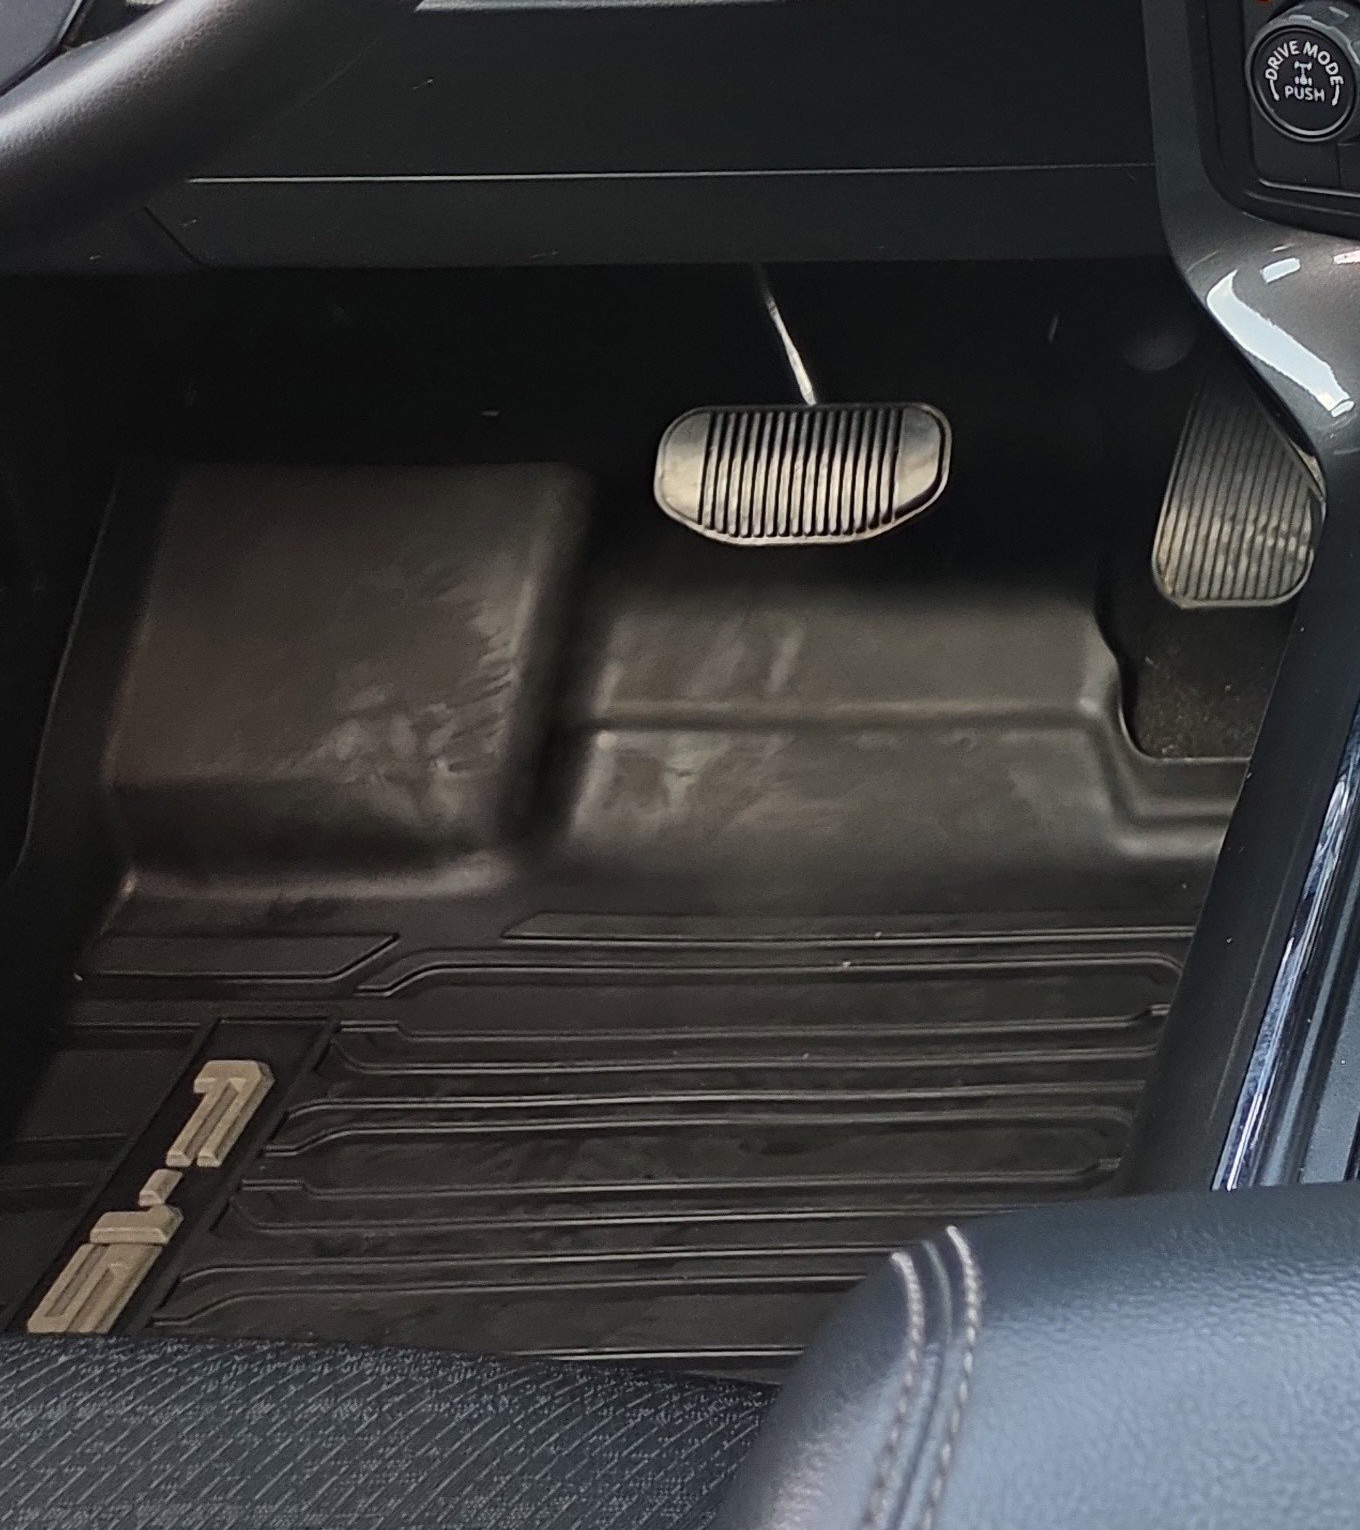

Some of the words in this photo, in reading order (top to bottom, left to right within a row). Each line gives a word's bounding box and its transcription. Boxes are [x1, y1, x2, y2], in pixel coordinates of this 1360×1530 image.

[1265, 40, 1300, 81] DRIVE
[1303, 43, 1344, 86] MODE
[1284, 85, 1326, 102] PUSH
